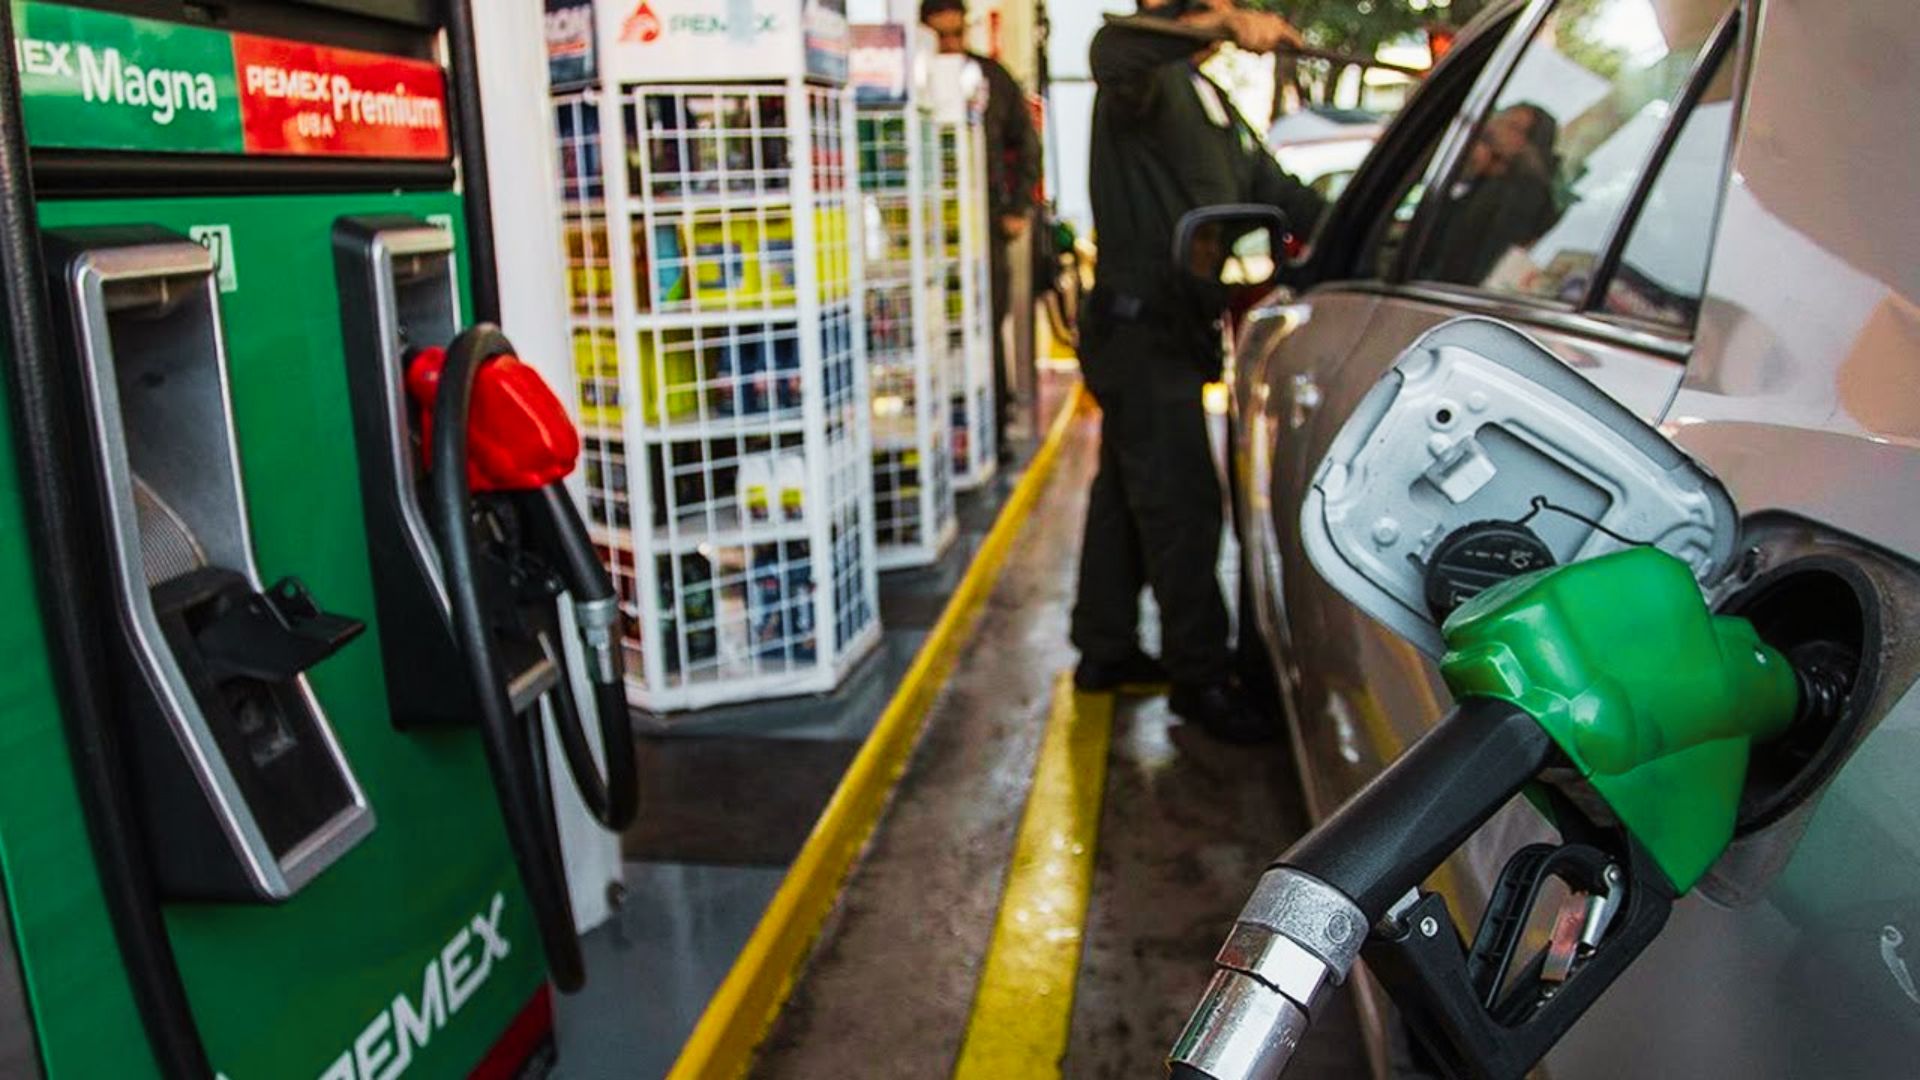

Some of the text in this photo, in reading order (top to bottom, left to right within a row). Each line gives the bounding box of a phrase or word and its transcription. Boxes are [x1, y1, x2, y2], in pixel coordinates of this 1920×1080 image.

[77, 44, 217, 124] Magna
[246, 64, 441, 129] PEMEX Premium
